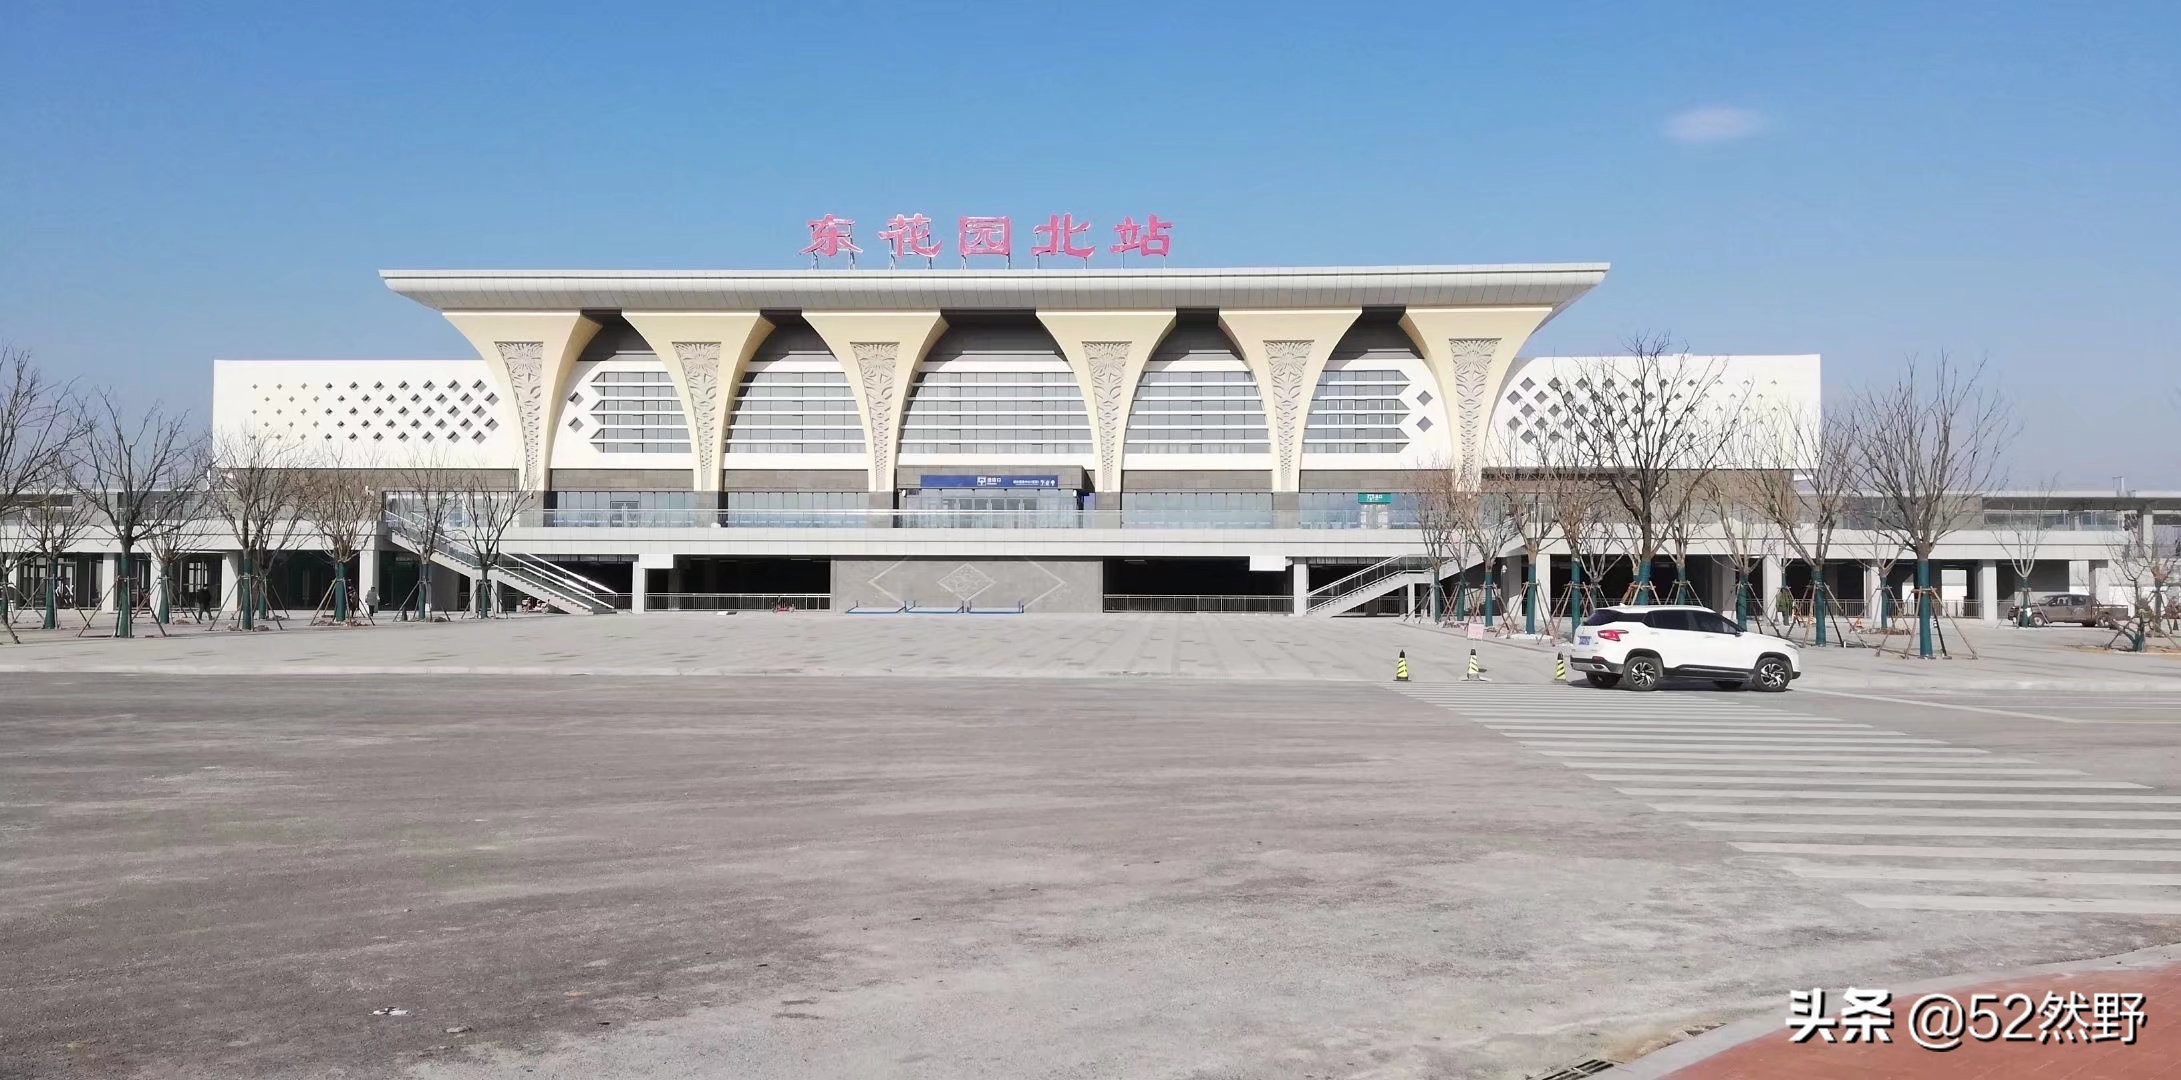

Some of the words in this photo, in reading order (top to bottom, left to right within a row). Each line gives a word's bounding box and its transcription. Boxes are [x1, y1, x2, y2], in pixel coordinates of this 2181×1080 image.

[800, 213, 1173, 258] 东花园北站
